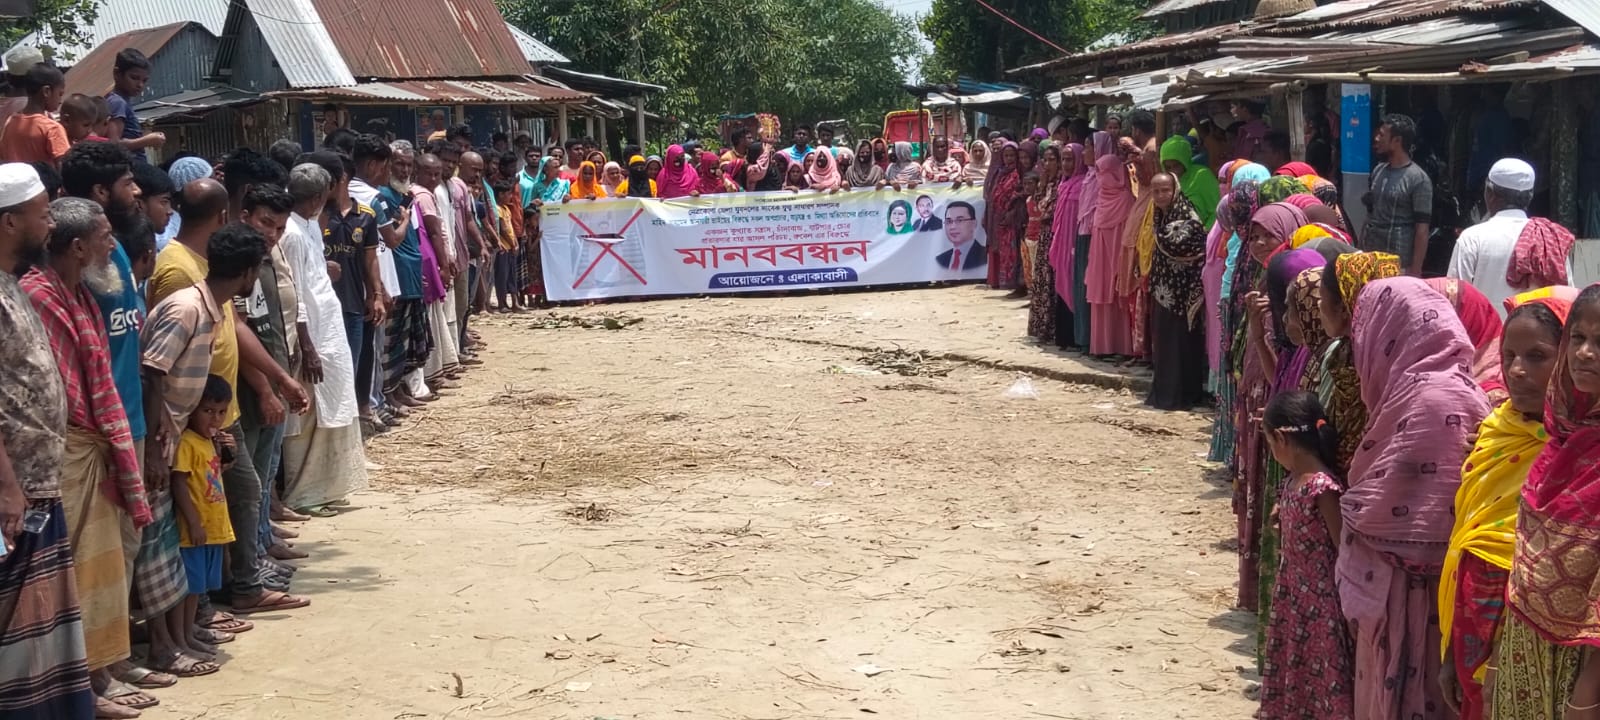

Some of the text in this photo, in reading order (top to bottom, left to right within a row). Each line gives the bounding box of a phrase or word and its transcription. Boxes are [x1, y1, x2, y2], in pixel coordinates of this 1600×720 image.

[717, 206, 733, 214] জেলা
[761, 204, 780, 212] সাবেক
[731, 227, 752, 235] কুখ্যাত
[827, 230, 850, 239] বিরুদ্ধে
[674, 240, 872, 270] মানববন্ধন
[717, 273, 775, 287] আয়োজনে
[787, 268, 848, 283] এলাকাবাসী
